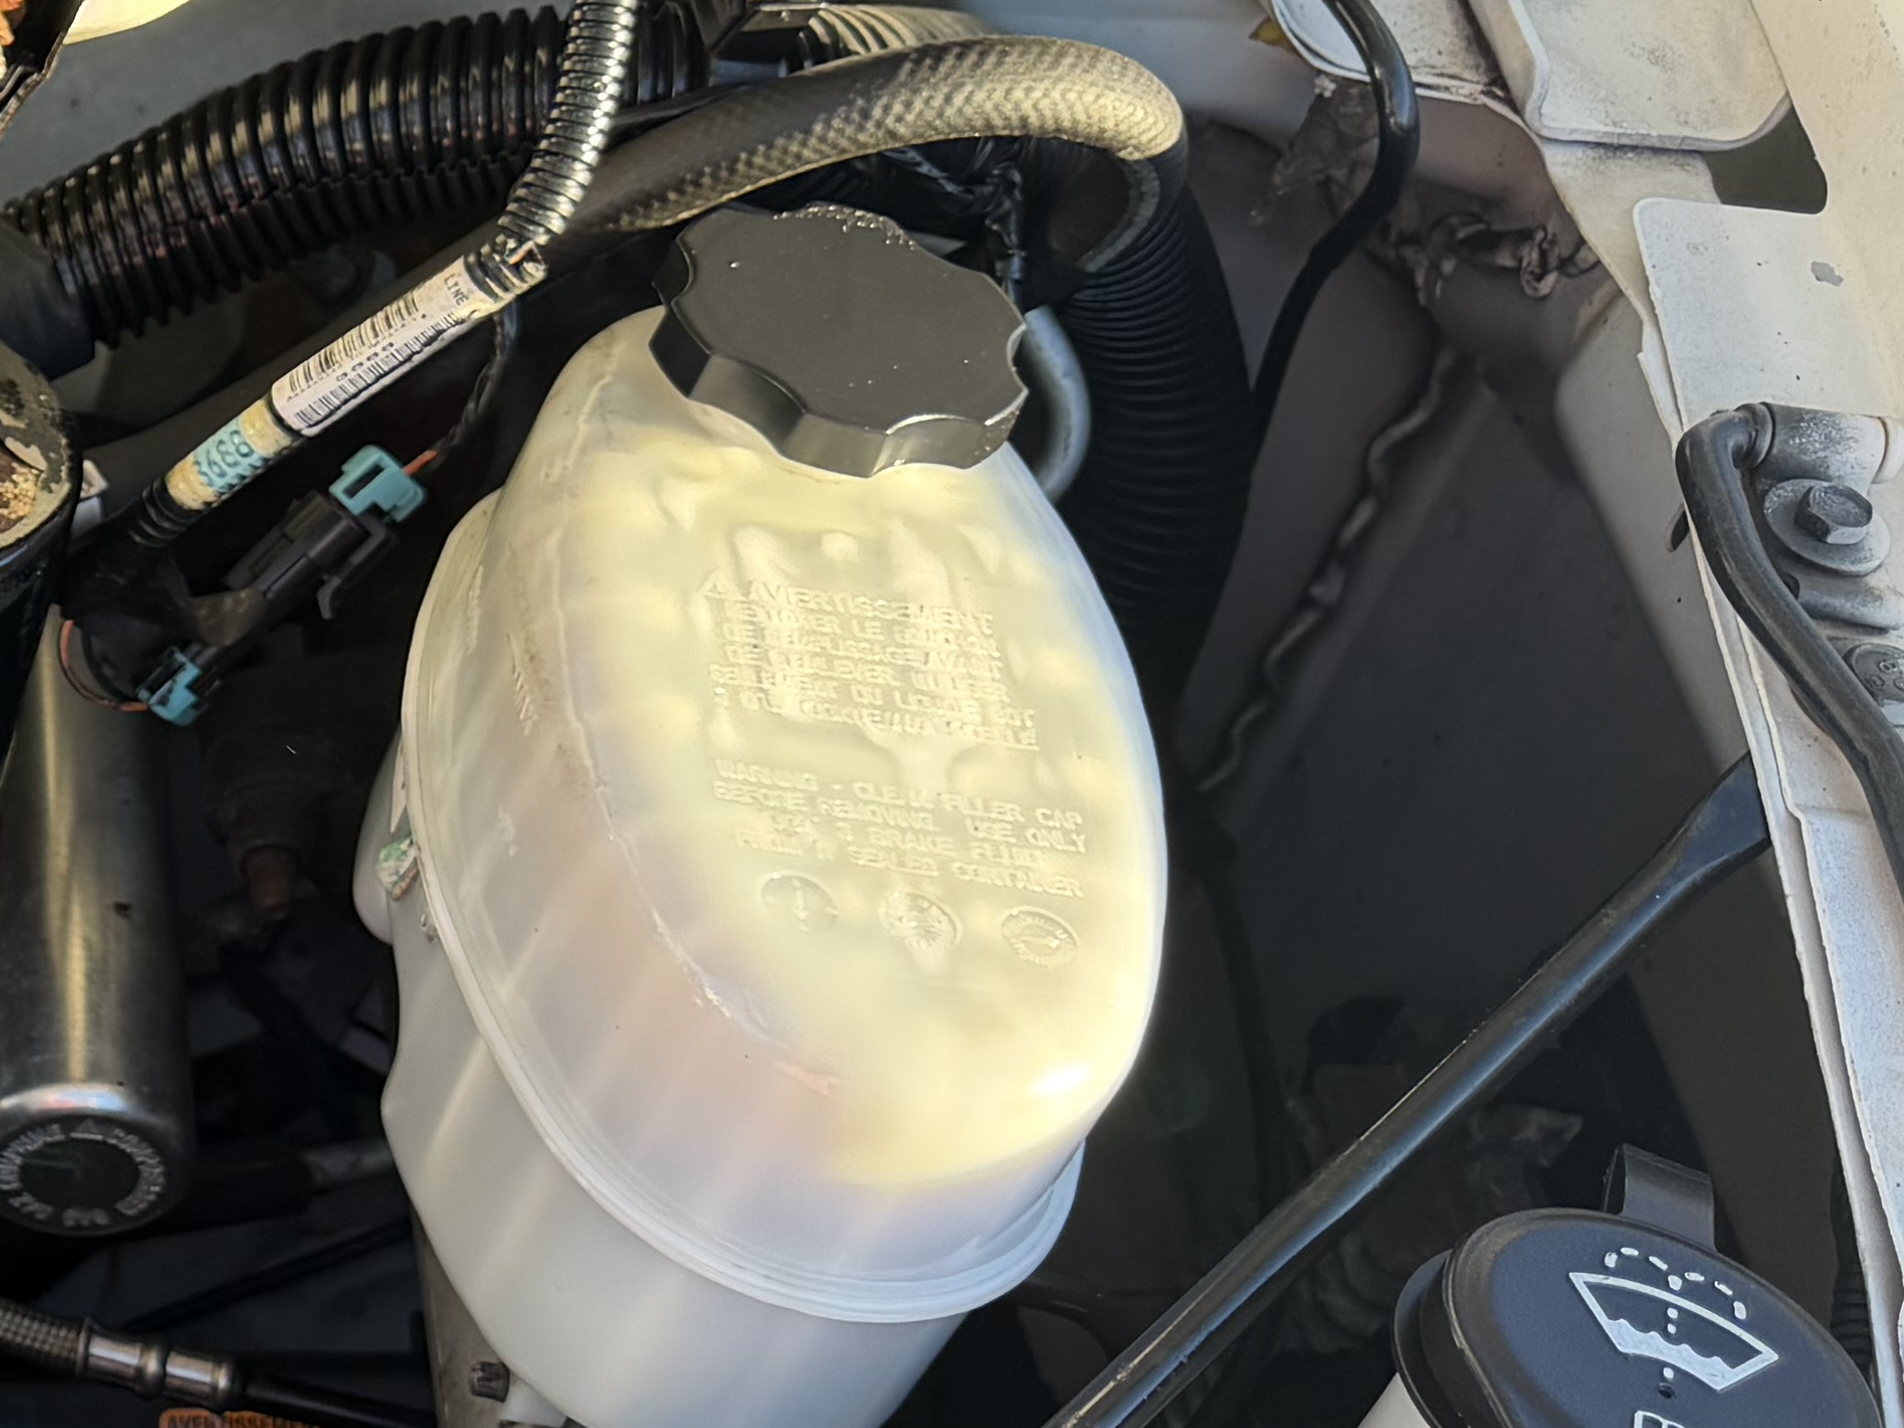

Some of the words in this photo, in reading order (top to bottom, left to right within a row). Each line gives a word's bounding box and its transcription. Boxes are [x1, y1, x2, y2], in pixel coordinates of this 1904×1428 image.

[443, 273, 468, 307] LINE
[1036, 808, 1083, 829] CAP
[1025, 828, 1086, 853] ONLY
